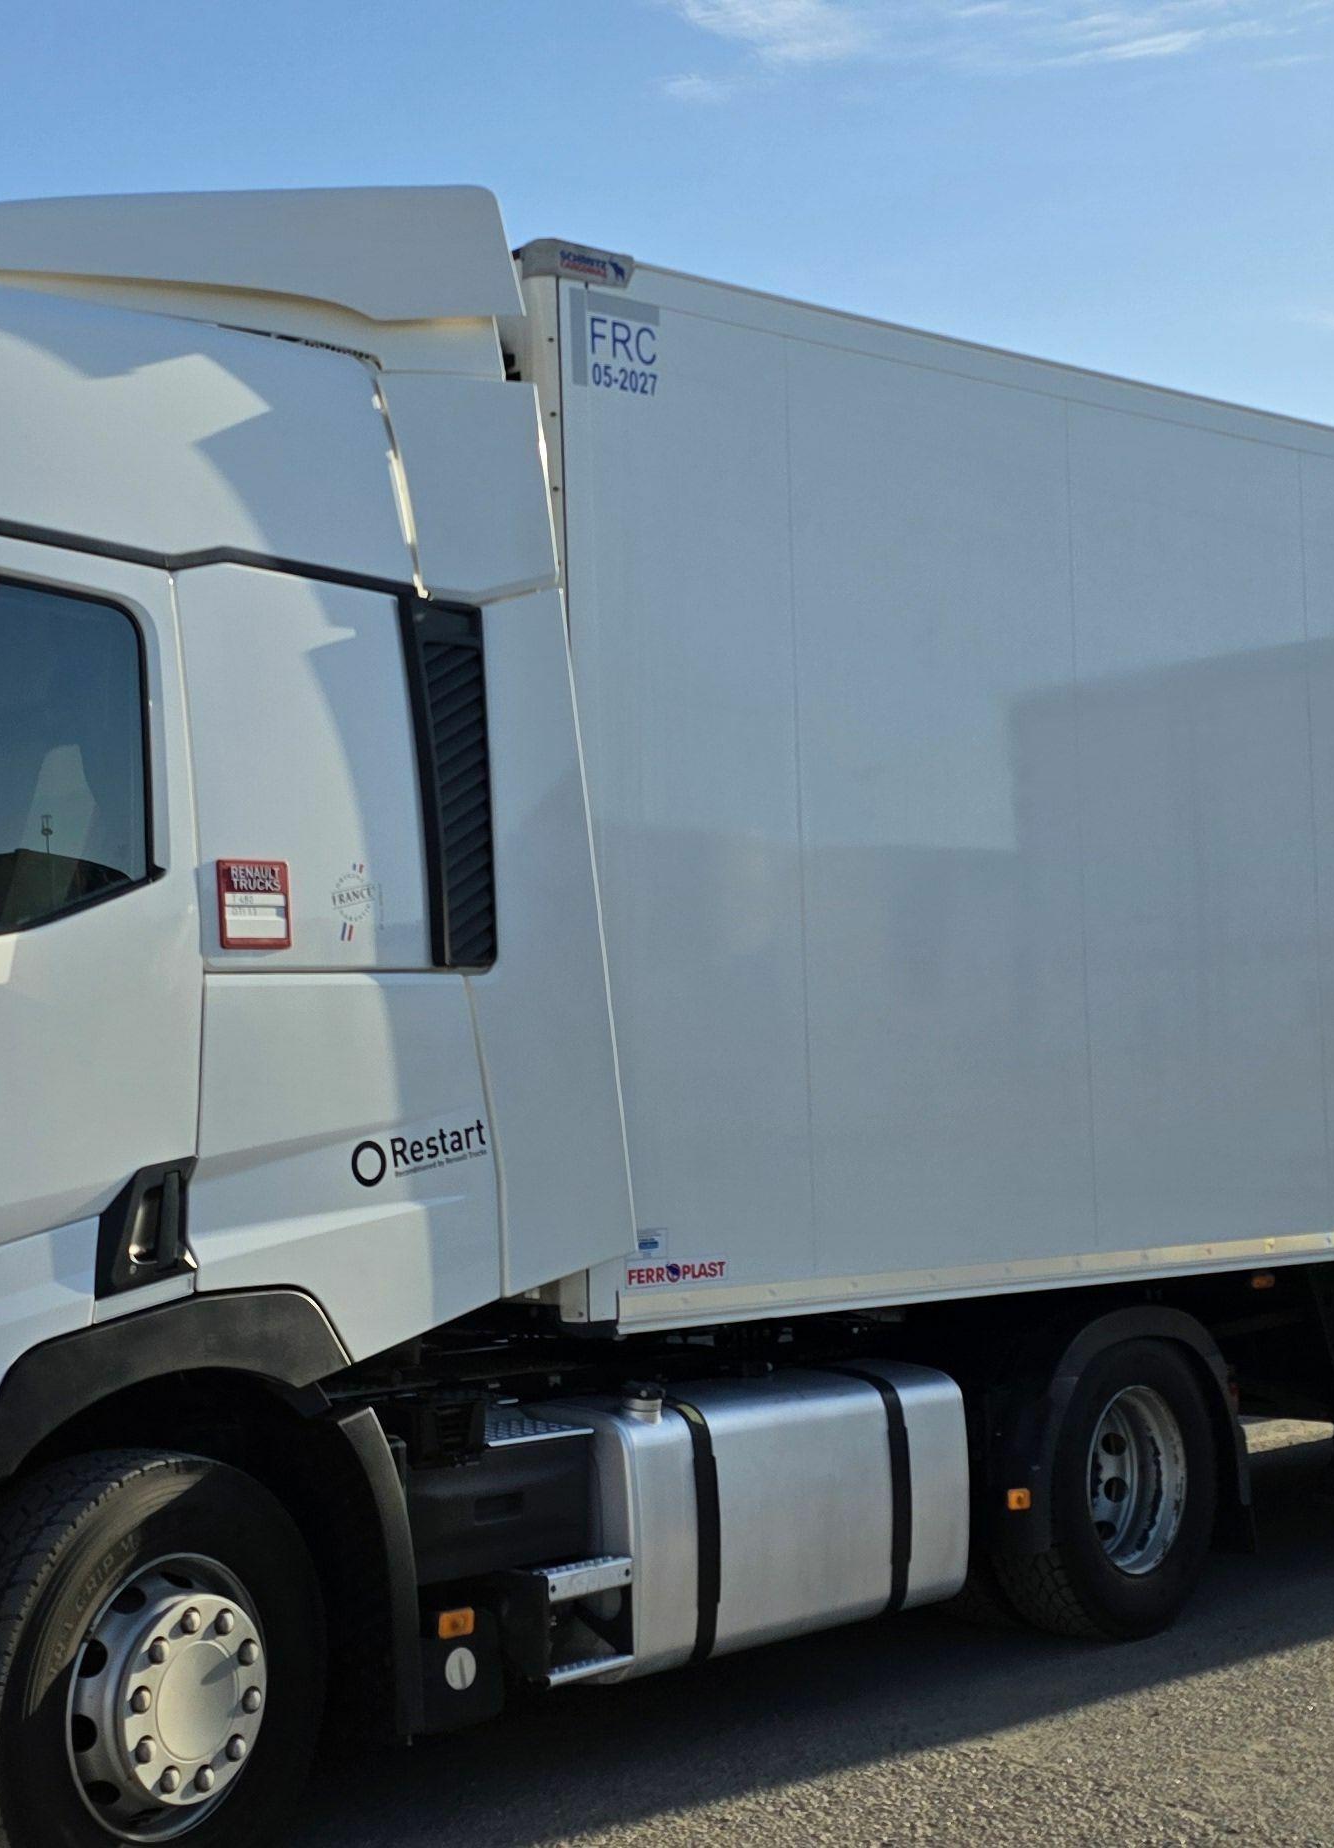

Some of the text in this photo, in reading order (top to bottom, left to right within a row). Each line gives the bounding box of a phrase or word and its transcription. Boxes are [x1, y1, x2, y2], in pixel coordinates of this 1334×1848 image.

[590, 317, 657, 366] FRC
[592, 362, 658, 397] 05-2027
[230, 865, 281, 881] RENAULT
[232, 879, 282, 892] TRUCKS
[390, 1119, 486, 1168] Restart
[628, 1261, 726, 1285] FERROPLAST
